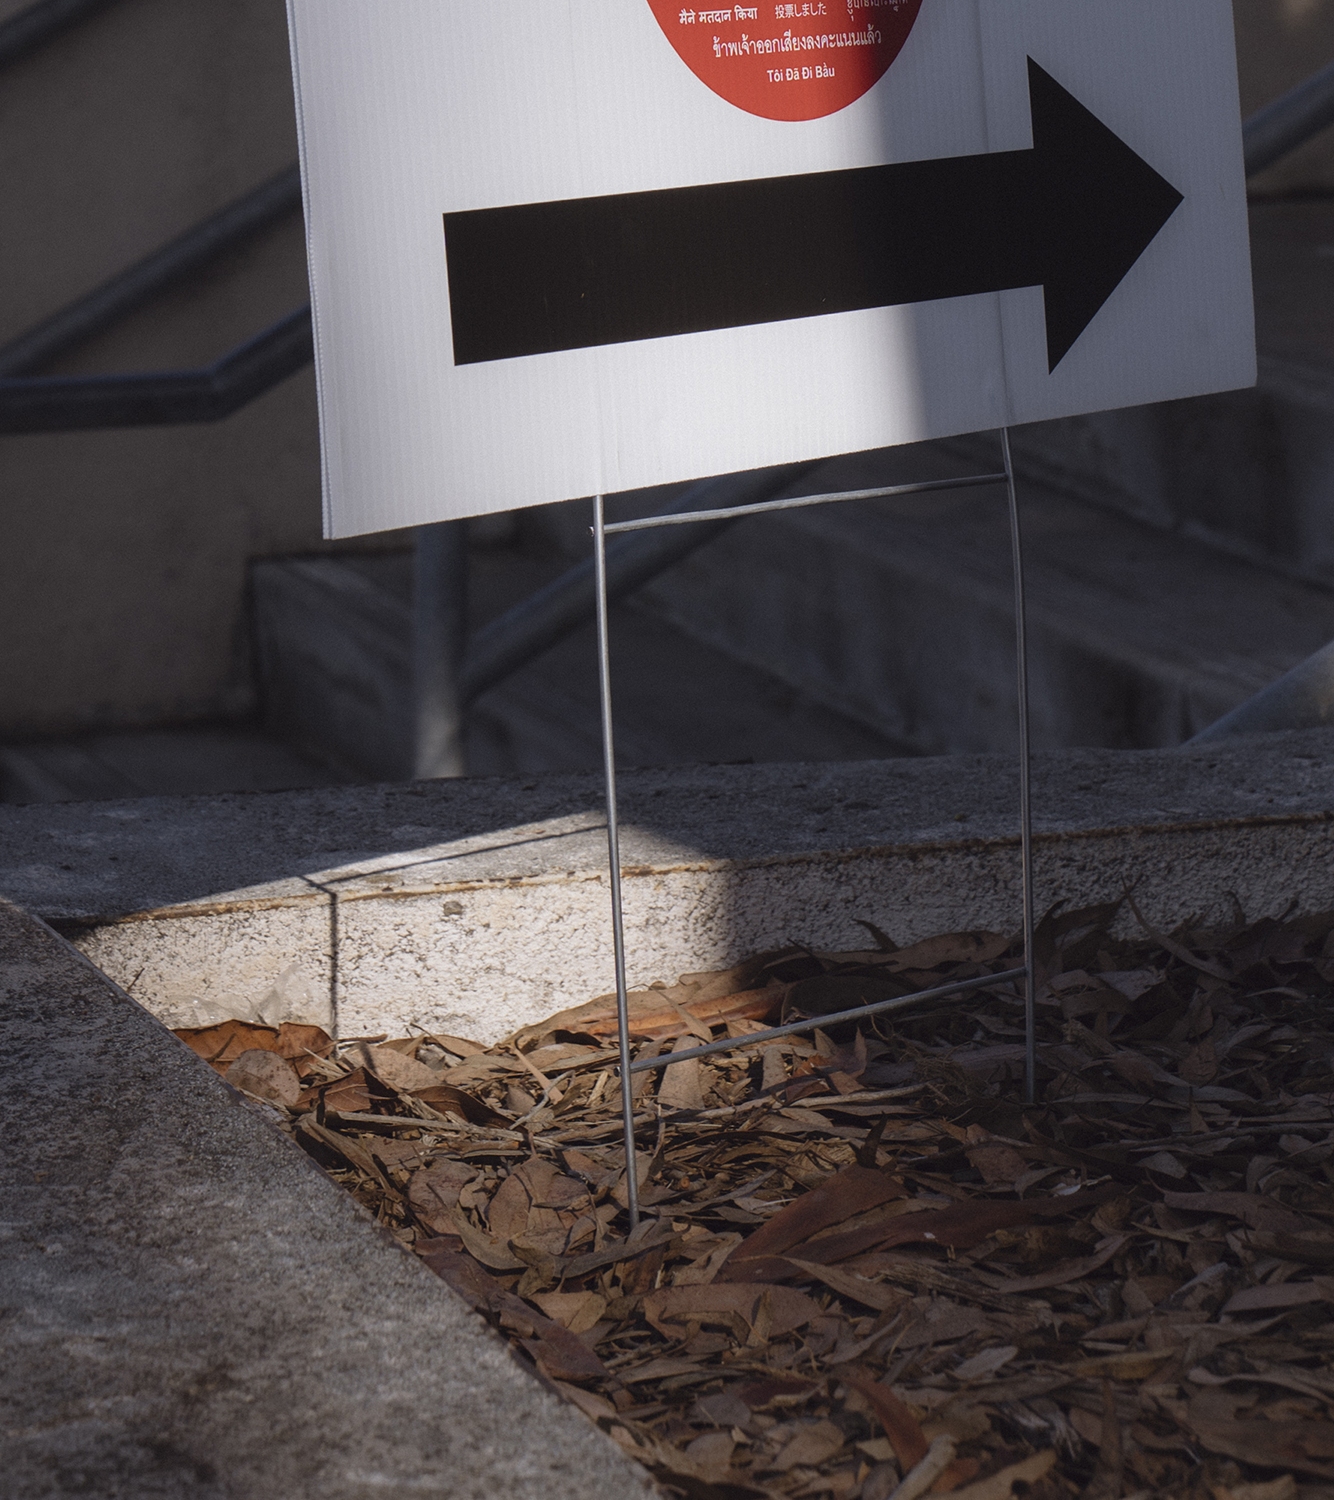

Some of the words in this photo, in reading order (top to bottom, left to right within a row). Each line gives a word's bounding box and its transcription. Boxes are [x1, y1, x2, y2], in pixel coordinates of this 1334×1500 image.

[698, 9, 732, 24] मतदान
[734, 4, 758, 21] किया
[775, 1, 827, 20] 投票しました
[713, 23, 882, 58] ข้าพเจ้าออกเสียงลงคะแนนแล้ว
[767, 69, 784, 83] Tôi
[785, 67, 800, 82] Đã
[801, 66, 813, 80] Đi
[815, 62, 836, 78] Bầu
